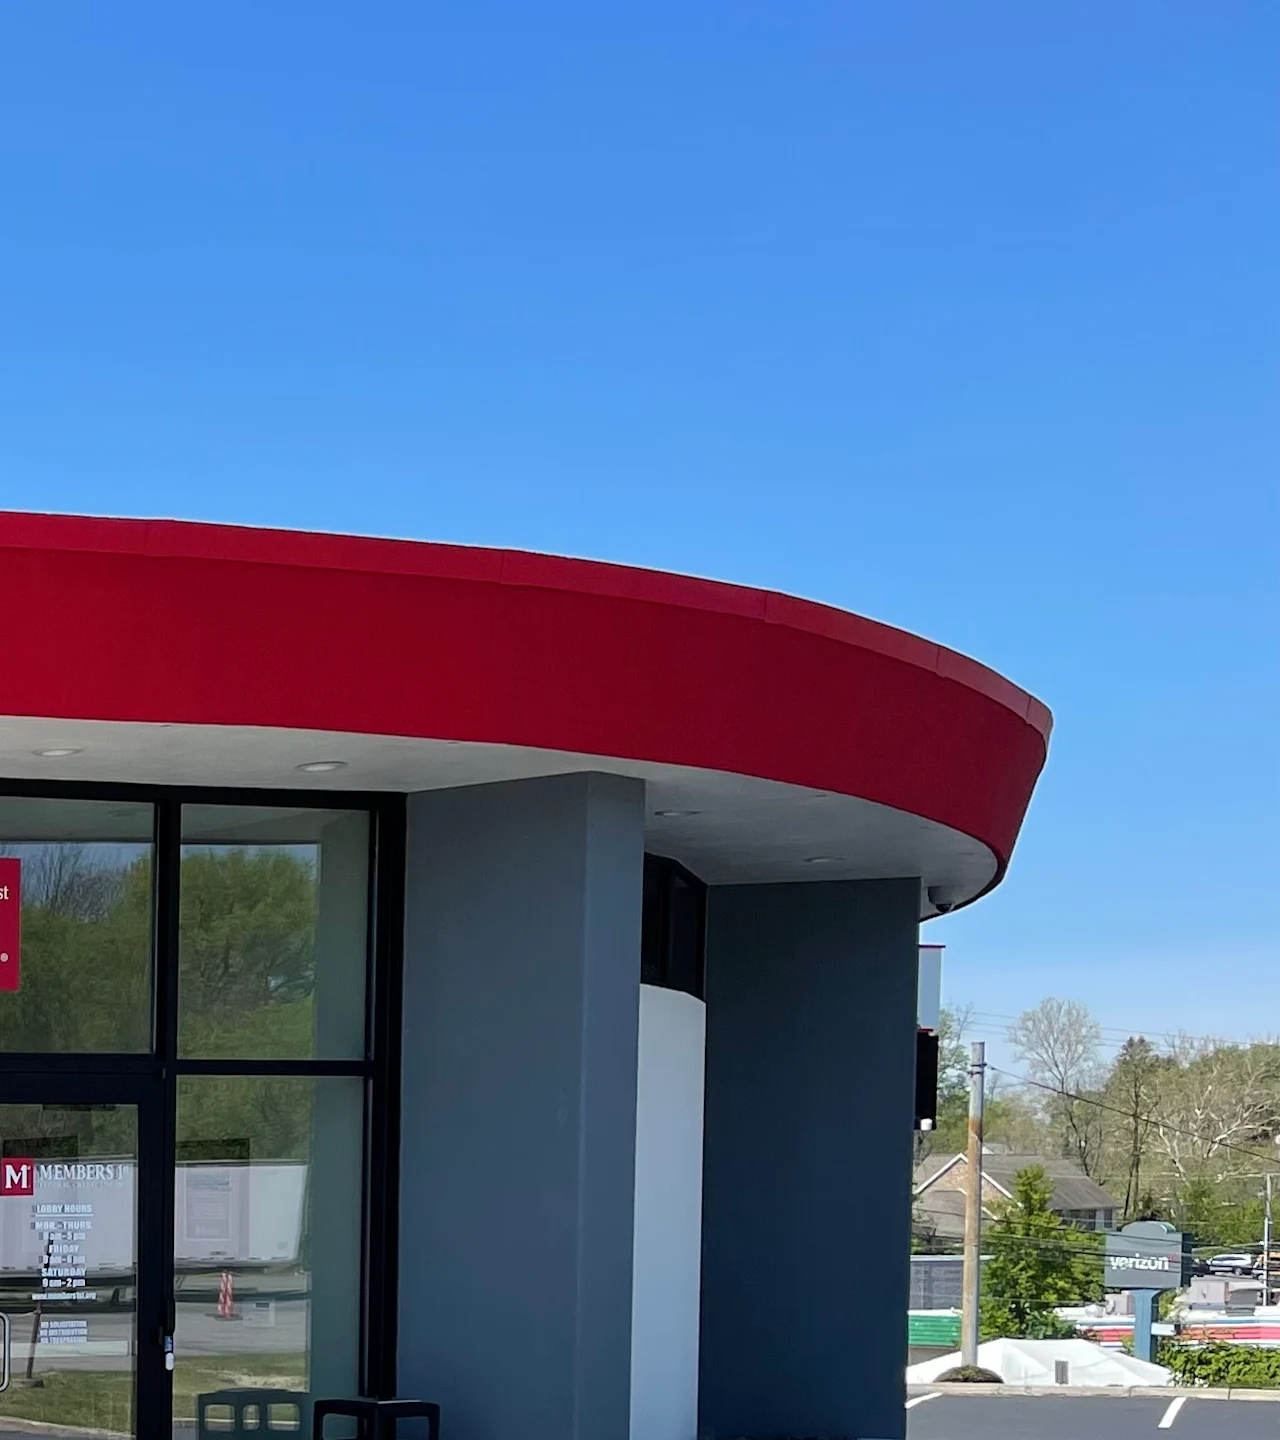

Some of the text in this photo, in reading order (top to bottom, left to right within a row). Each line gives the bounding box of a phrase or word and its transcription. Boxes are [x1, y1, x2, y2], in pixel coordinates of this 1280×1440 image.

[40, 1164, 113, 1180] MEMBERS
[37, 1204, 92, 1213] LOBBY HOURS
[49, 1244, 79, 1253] FRIDAY
[1110, 1252, 1169, 1270] verizon
[41, 1268, 87, 1277] SATURDAY
[42, 1278, 48, 1287] 9
